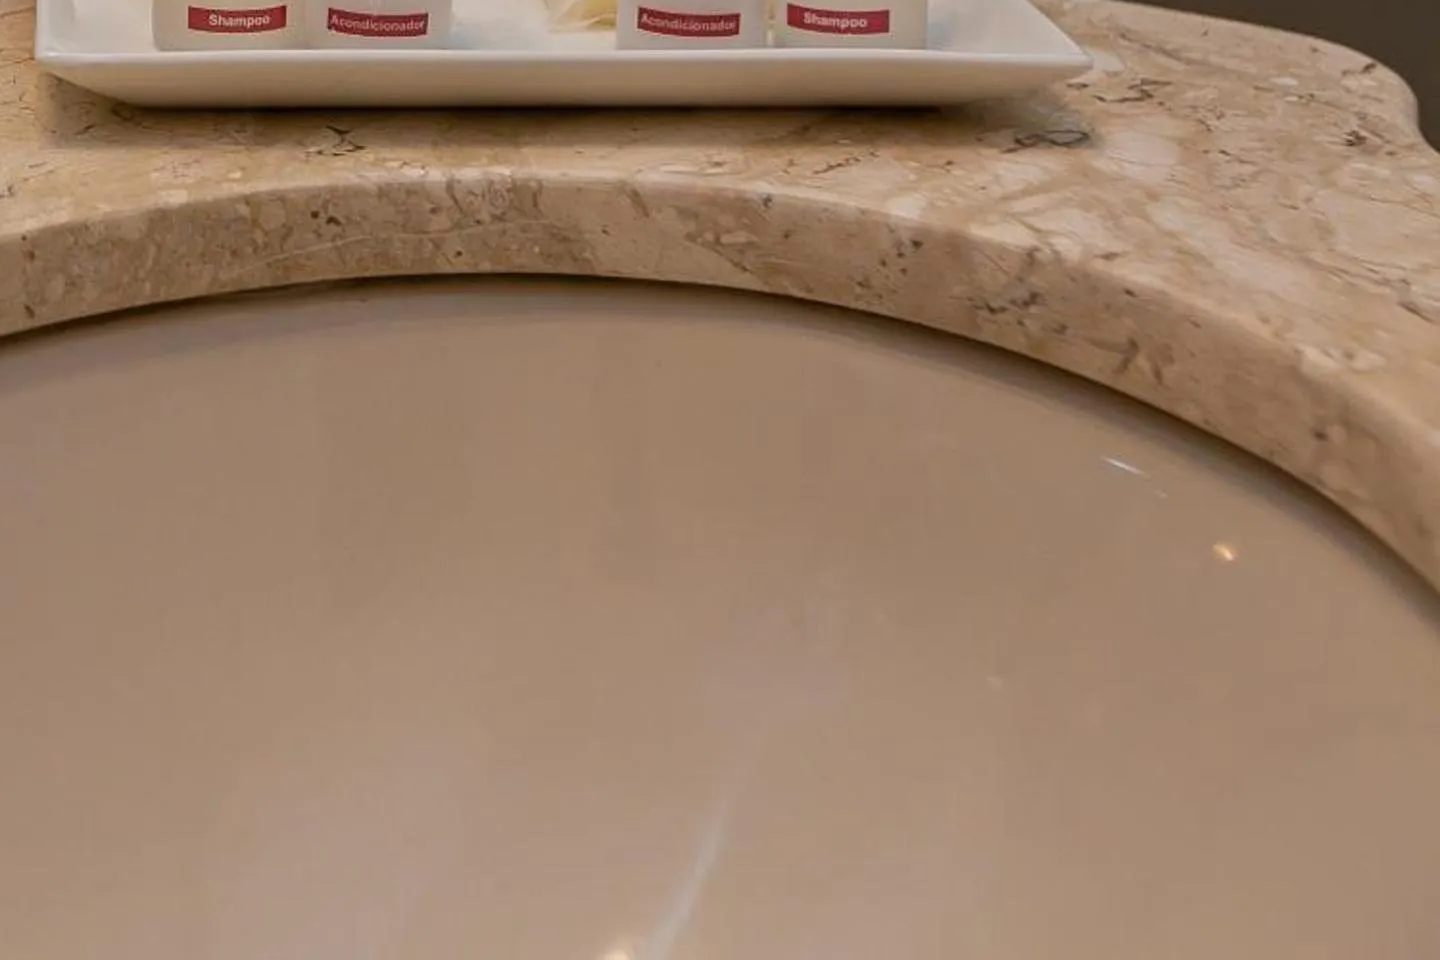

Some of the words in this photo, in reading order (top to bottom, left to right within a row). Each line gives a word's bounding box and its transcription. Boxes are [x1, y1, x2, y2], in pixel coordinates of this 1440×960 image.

[208, 13, 271, 29] Shampoo
[330, 14, 426, 31] Acondicionador
[641, 13, 736, 30] Acondicionador
[803, 11, 869, 31] Shampoo
